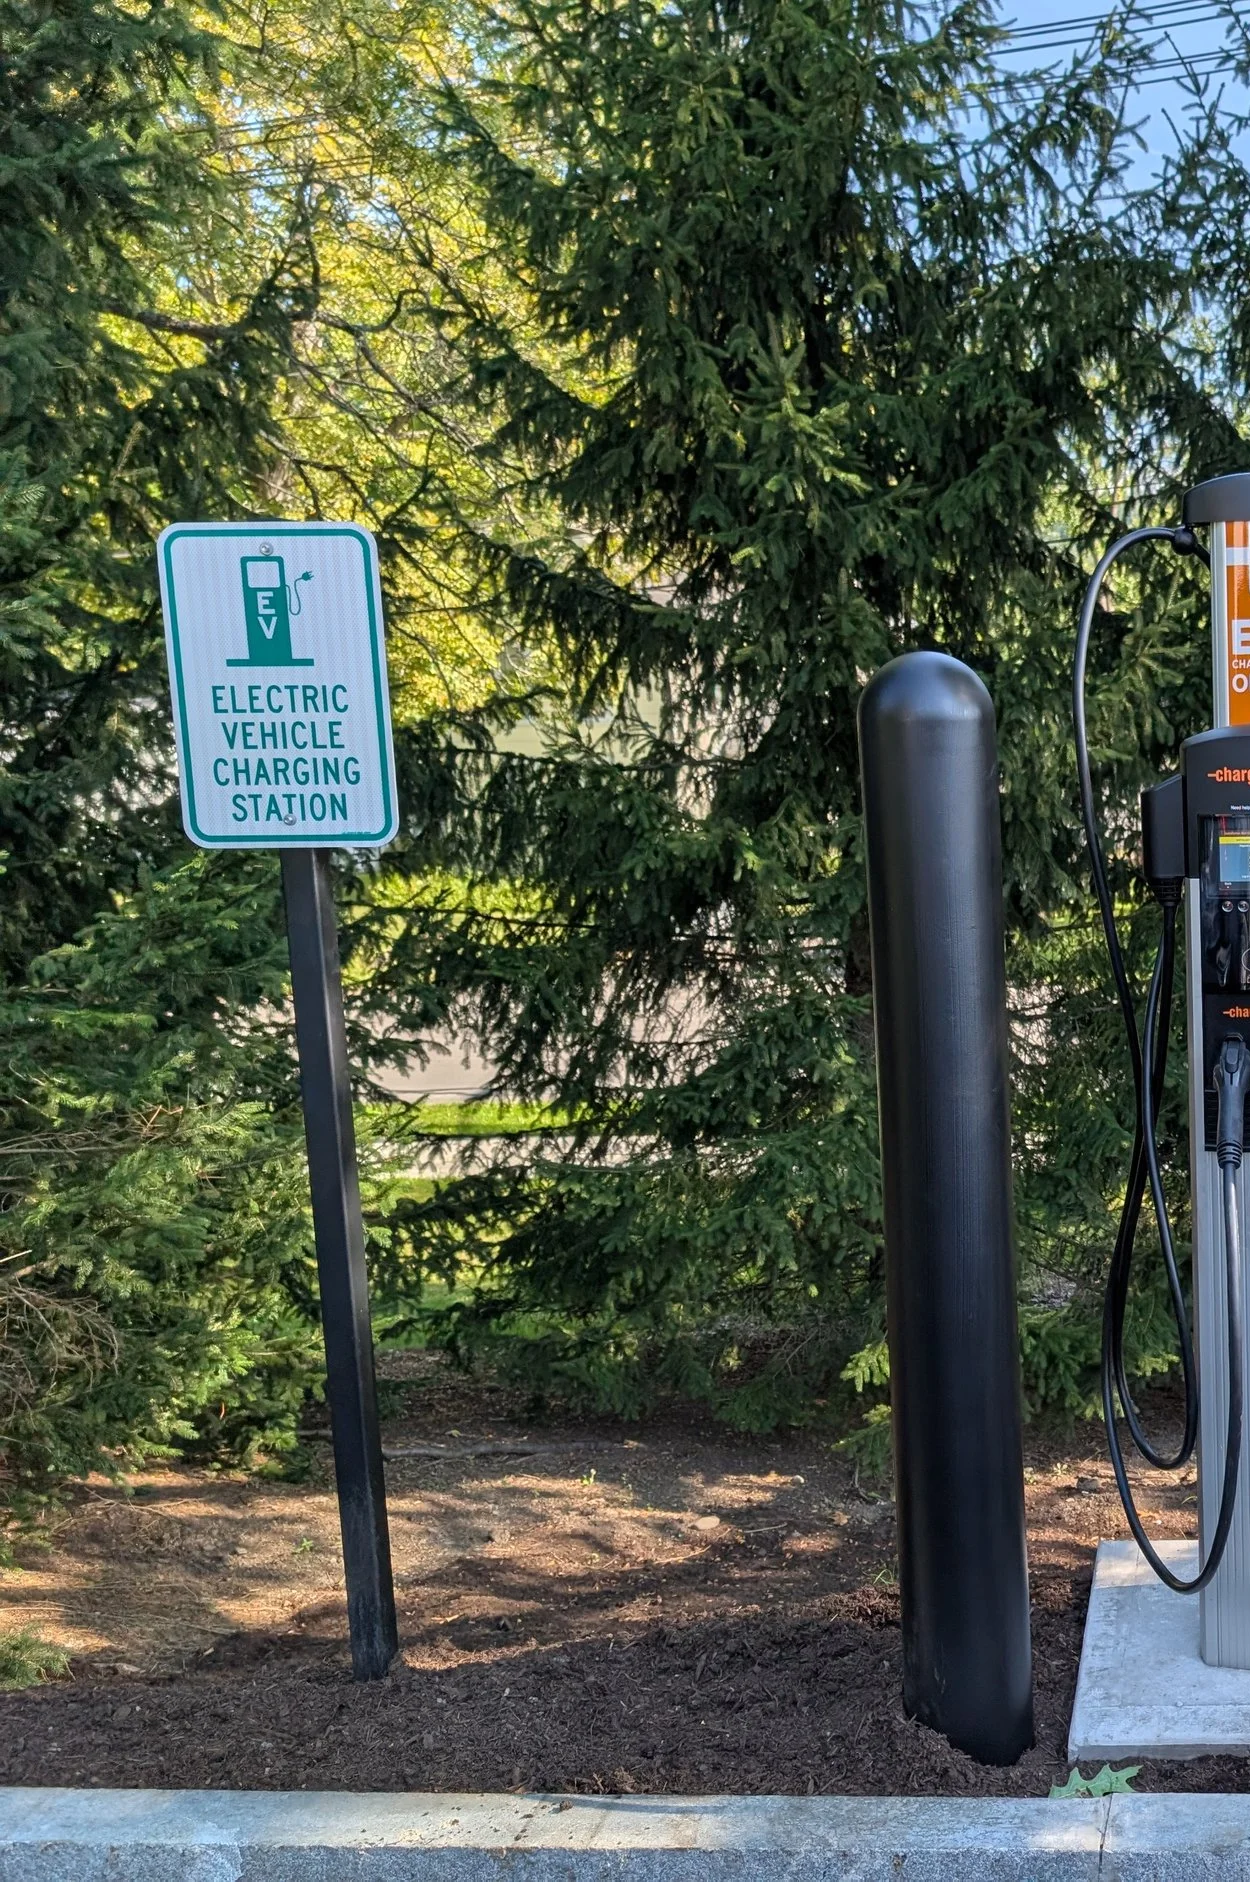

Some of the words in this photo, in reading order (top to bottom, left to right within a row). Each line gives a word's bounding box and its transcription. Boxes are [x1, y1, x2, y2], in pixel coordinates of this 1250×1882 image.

[256, 591, 277, 640] EV
[211, 684, 349, 714] ELECTRIC
[221, 721, 346, 750] VEHICLE
[212, 756, 361, 786] CHARGING
[231, 793, 348, 822] STATION
